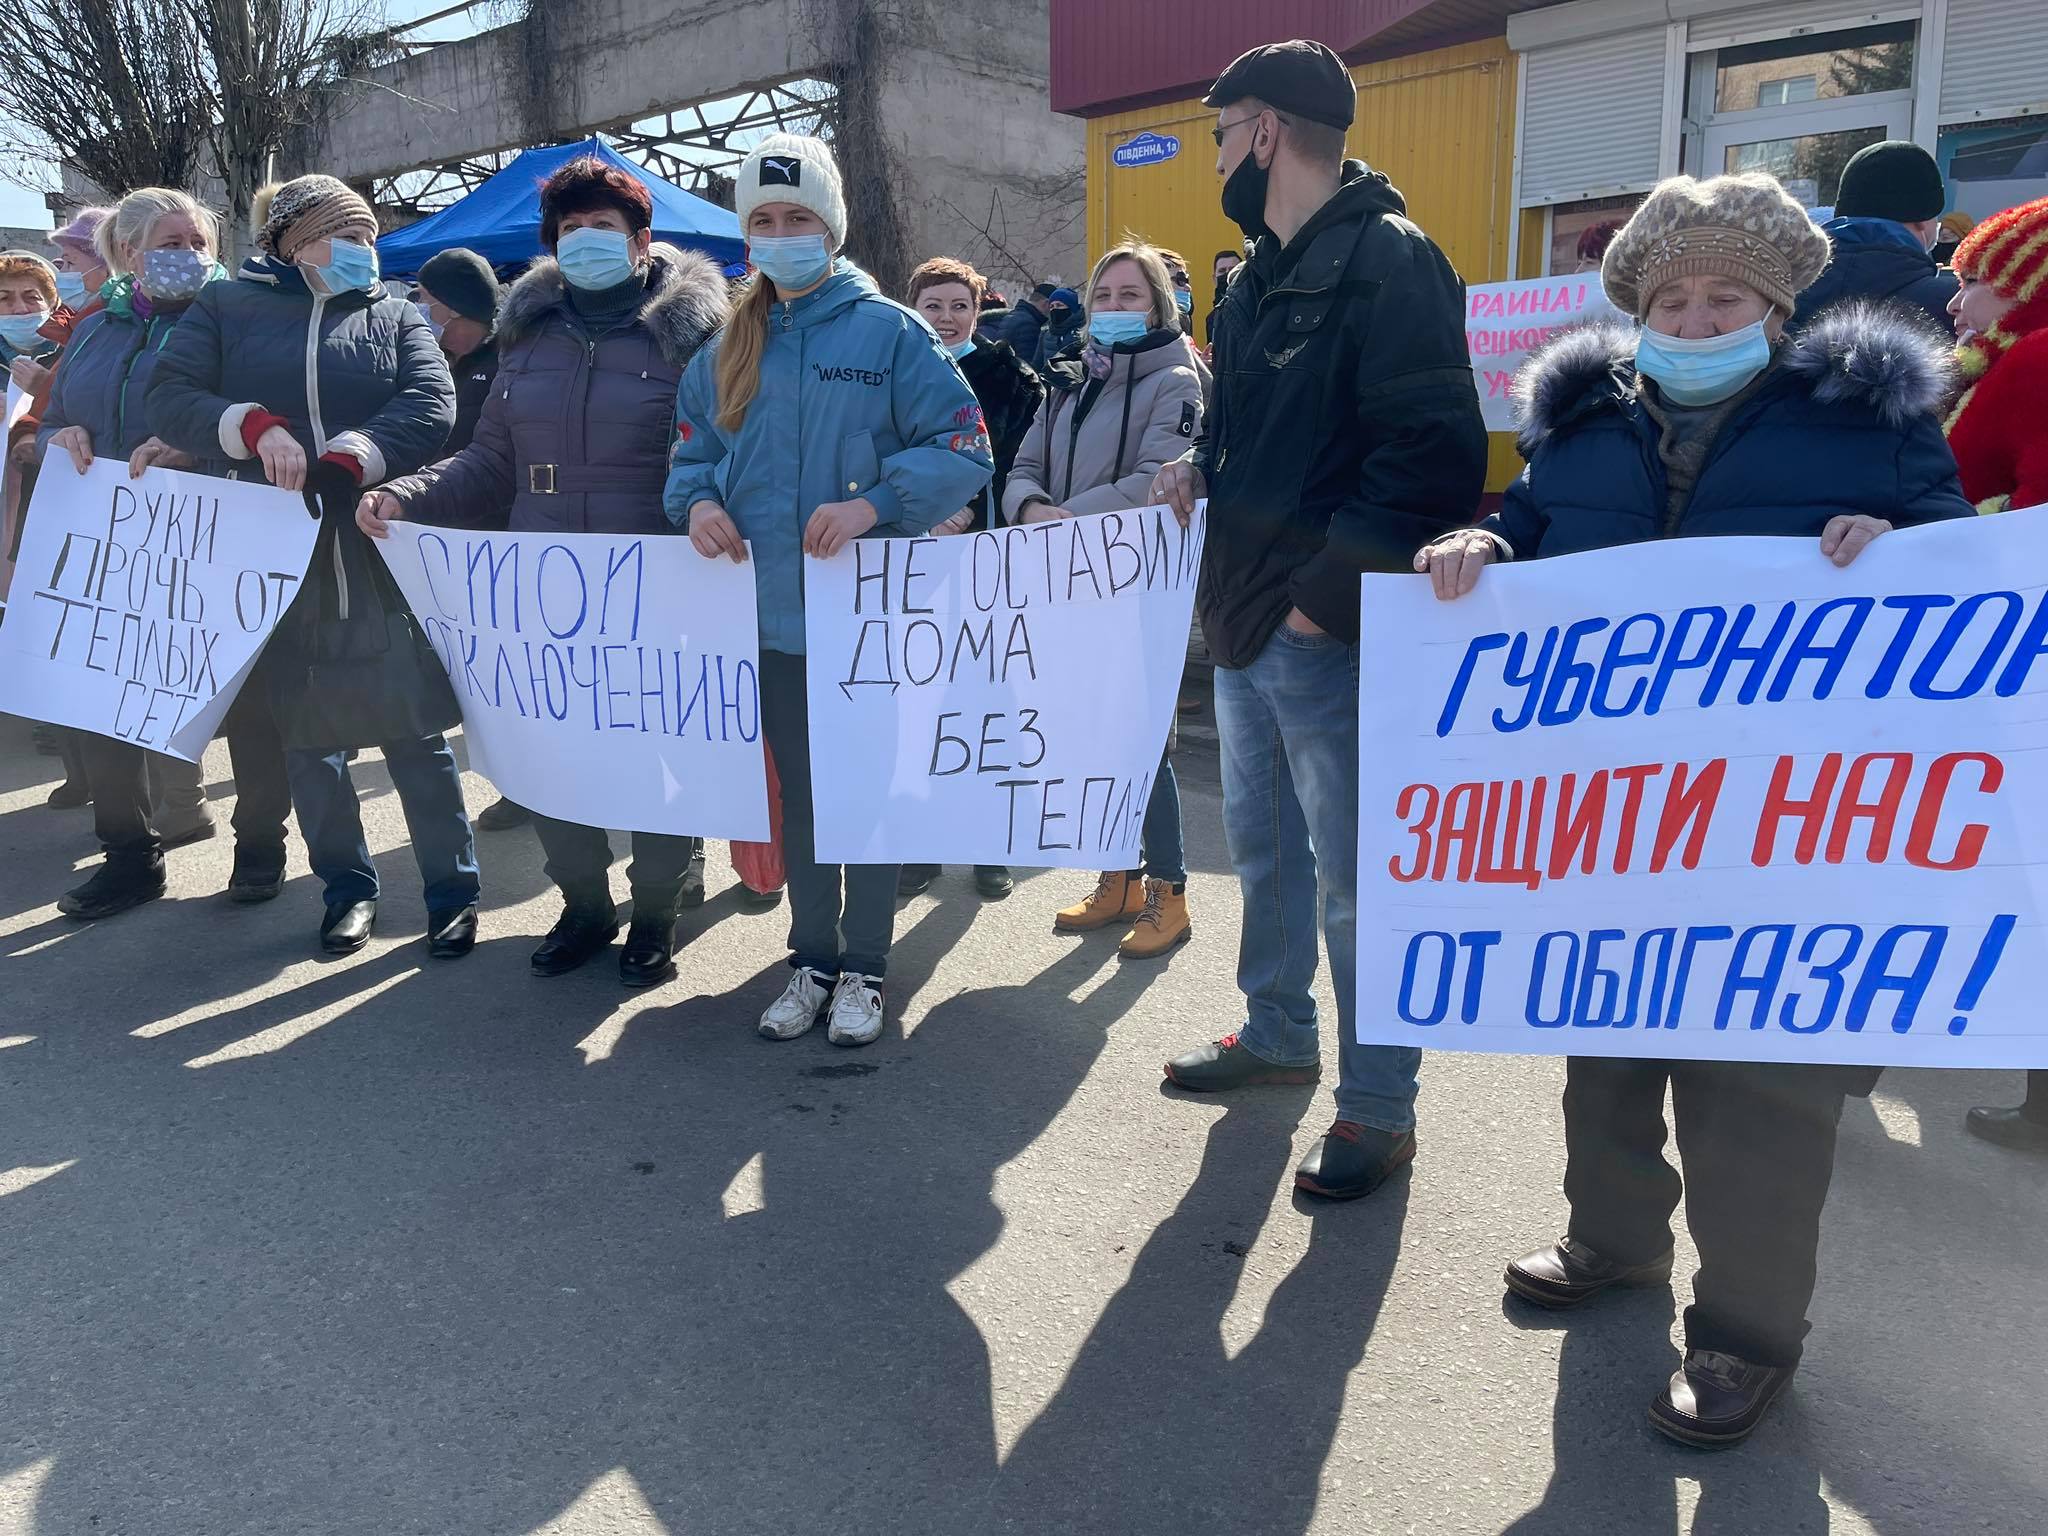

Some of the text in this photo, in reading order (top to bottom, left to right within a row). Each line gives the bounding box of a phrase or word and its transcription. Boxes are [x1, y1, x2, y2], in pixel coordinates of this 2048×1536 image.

[1117, 141, 1177, 161] ПІВДЕННА, 1а
[1467, 284, 1586, 318] РАИНА!
[109, 485, 218, 563] РУКИ
[854, 505, 1206, 615] НЕ ОСТАВИМ
[48, 533, 298, 633] ПРОЧЬ ОТ
[417, 533, 643, 641] СТОП
[33, 591, 219, 696] ТЕПЛЫХ
[838, 613, 1037, 702] ДОМА
[115, 680, 209, 752] СЕТ
[929, 708, 1046, 776] БЕЗ
[995, 771, 1149, 855] ТЕПЛА
[1387, 752, 2005, 891] ЗАЩИТИ НАС
[1397, 914, 2019, 1037] ОТ ОБЛГАЗА!
